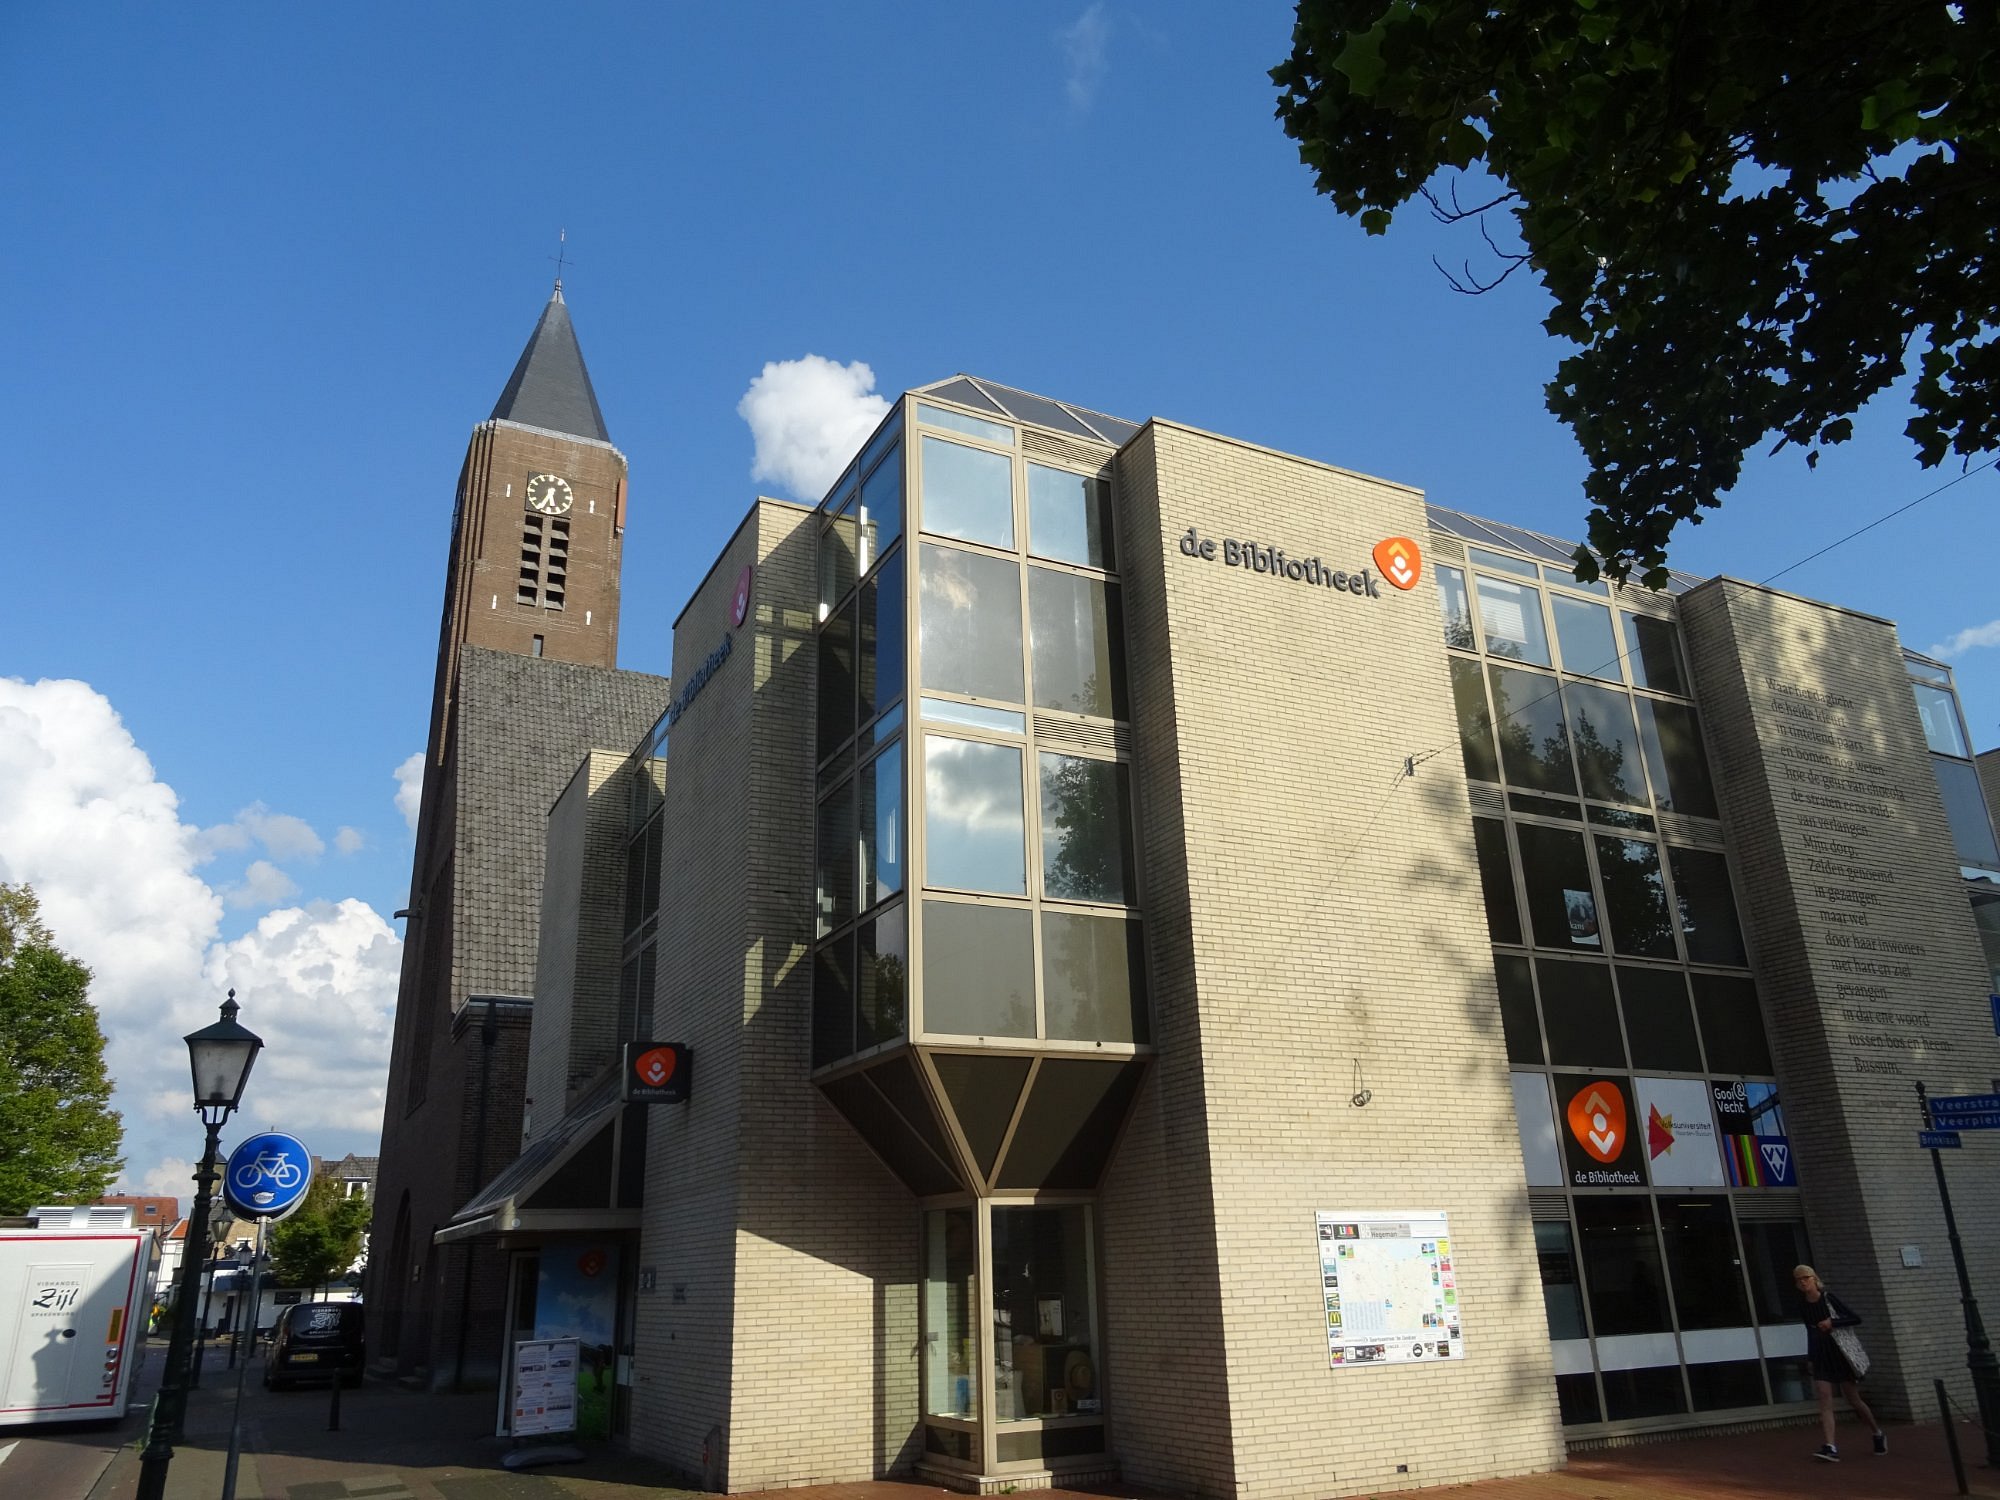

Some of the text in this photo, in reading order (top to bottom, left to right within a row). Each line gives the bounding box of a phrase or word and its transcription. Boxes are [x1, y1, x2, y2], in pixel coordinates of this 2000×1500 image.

[1180, 527, 1381, 599] de Bibliotheek
[1765, 677, 1792, 695] Waar
[1795, 685, 1811, 699] het
[1771, 699, 1785, 713] de
[1786, 701, 1813, 719] heide
[1776, 720, 1786, 735] in
[1837, 737, 1864, 751] paars
[1781, 746, 1886, 775] en bomen nog weten
[1784, 764, 1806, 781] hoe
[1808, 769, 1820, 784] de
[1823, 776, 1844, 789] geur
[1848, 780, 1865, 793] van
[1791, 789, 1895, 818] de straten eens vulde
[1797, 815, 1816, 827] van
[1802, 834, 1827, 853] Mijn
[1808, 859, 1895, 883] Zelden genoemd
[1813, 882, 1825, 897] in
[1819, 910, 1868, 926] maar wel
[1825, 930, 1926, 955] door haar inwoners
[1831, 957, 1911, 977] met hart en ziel
[1836, 984, 1888, 1001] gevangen
[1842, 1005, 1930, 1026] in dat ene woord
[1848, 1034, 1884, 1047] tussen
[1885, 1032, 1905, 1048] bos
[1907, 1039, 1920, 1049] en
[1714, 1088, 1734, 1100] Gooi
[1717, 1101, 1745, 1113] Vecht
[1935, 1099, 2000, 1110] Veerstra
[1660, 1120, 1712, 1130] Volksuniversiteit
[1937, 1115, 2000, 1126] Veerplei
[1575, 1170, 1640, 1184] de Bibliotheek
[32, 1287, 79, 1311] Zijl
